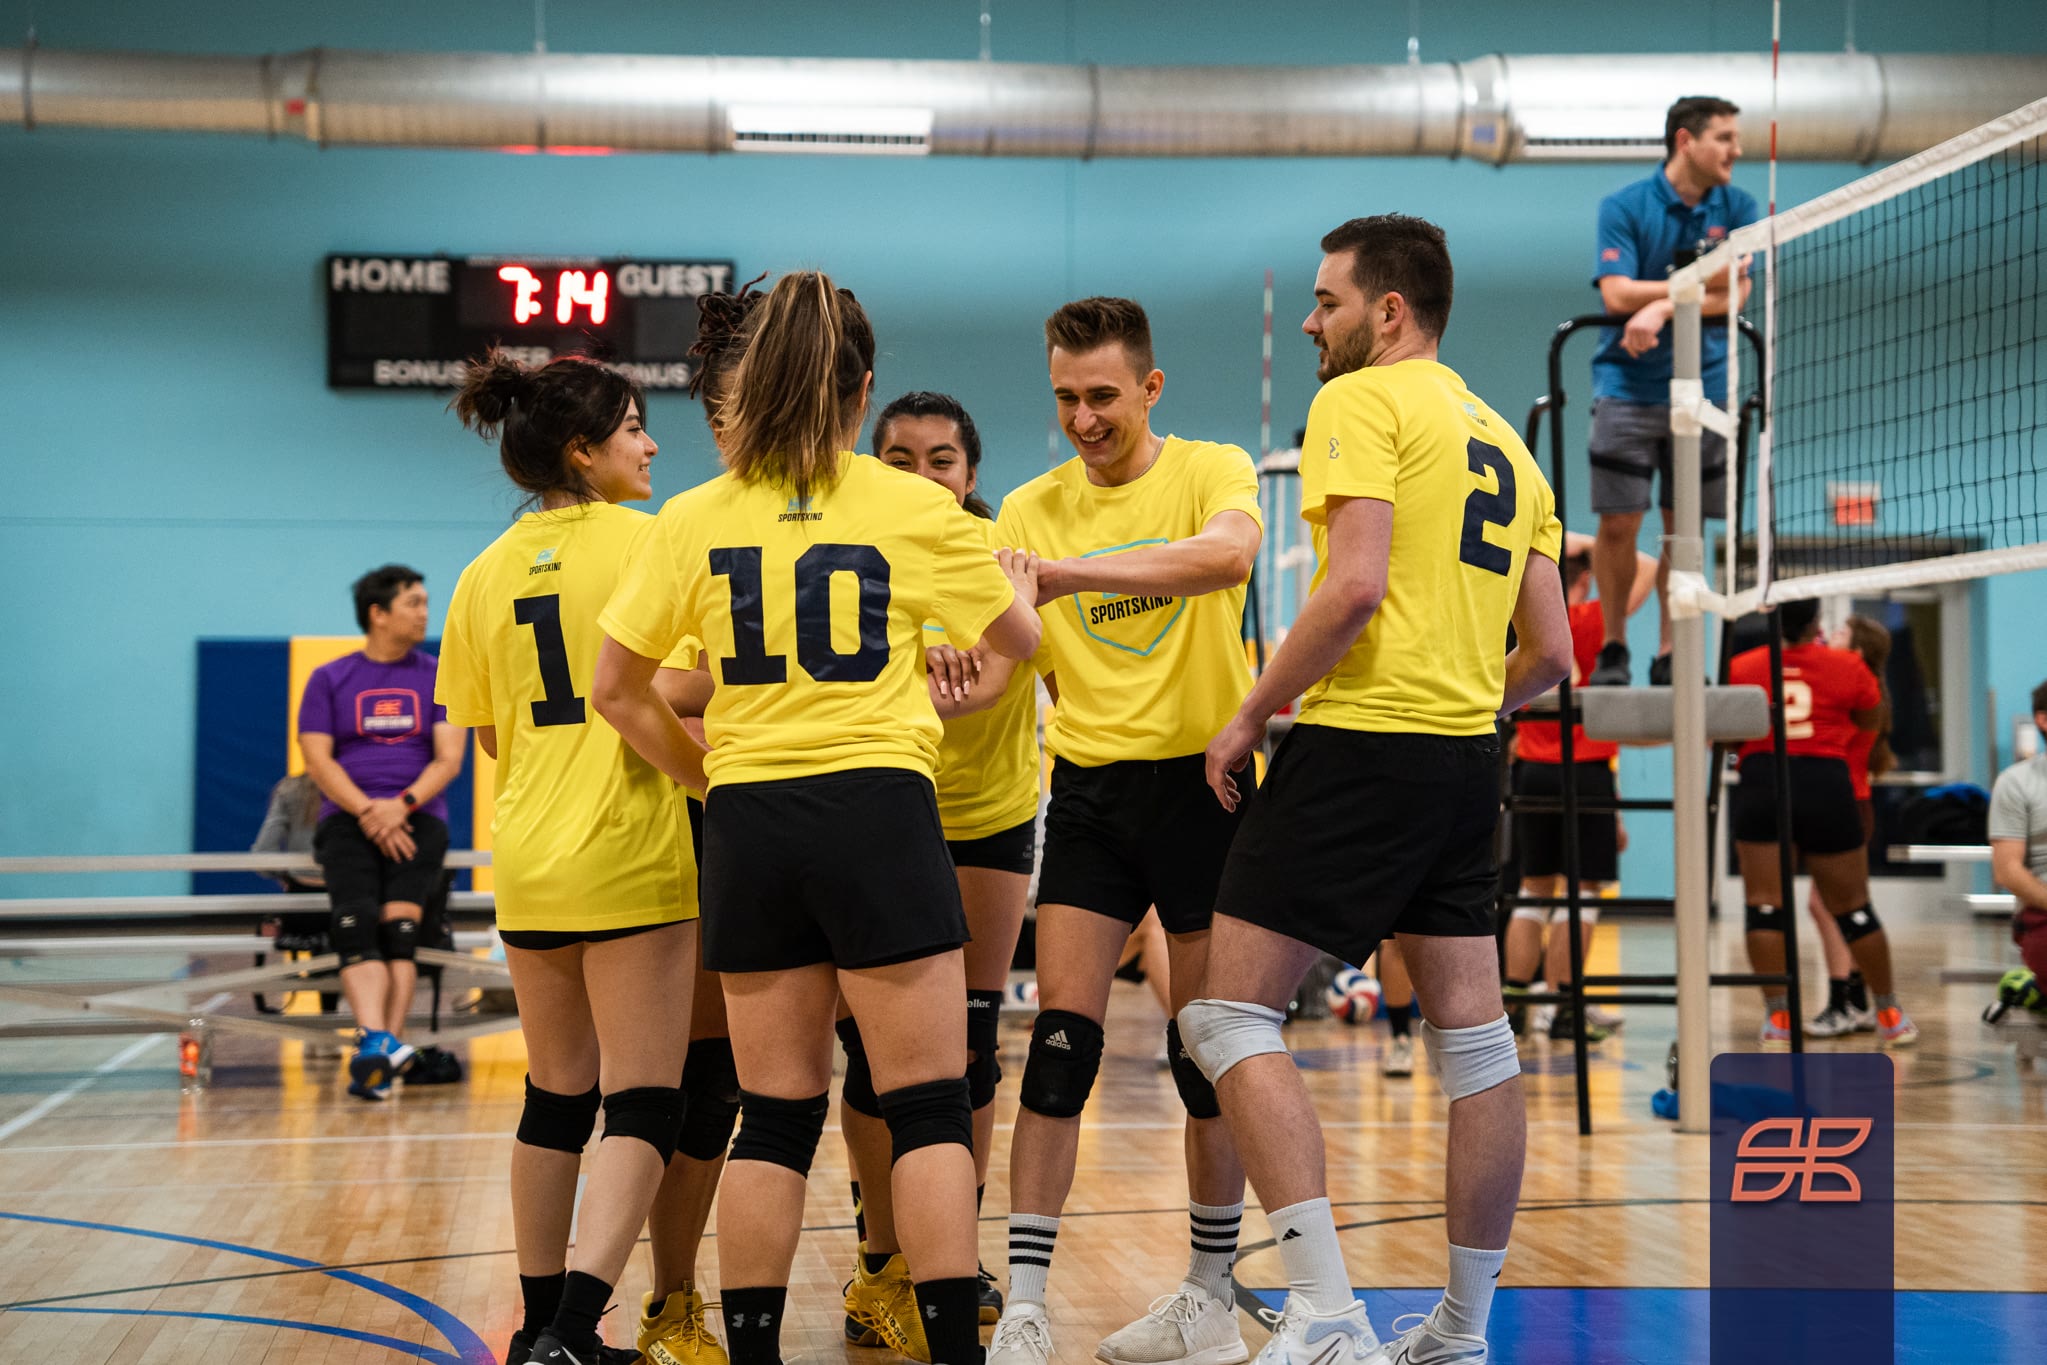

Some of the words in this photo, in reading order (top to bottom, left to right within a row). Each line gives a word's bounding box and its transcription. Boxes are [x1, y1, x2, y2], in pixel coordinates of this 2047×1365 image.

[331, 259, 451, 294] HOME
[616, 264, 731, 297] GUEST
[498, 265, 609, 325] 7:14
[374, 359, 468, 386] BONUS
[777, 512, 823, 523] SPORTSKIND
[1459, 435, 1517, 576] 2
[528, 561, 562, 576] SPORTSKIND
[708, 543, 891, 686] 10
[1090, 595, 1173, 625] SPORTSKIND
[513, 593, 587, 727] 1
[1782, 679, 1815, 740] 2
[1045, 1038, 1071, 1051] adidas
